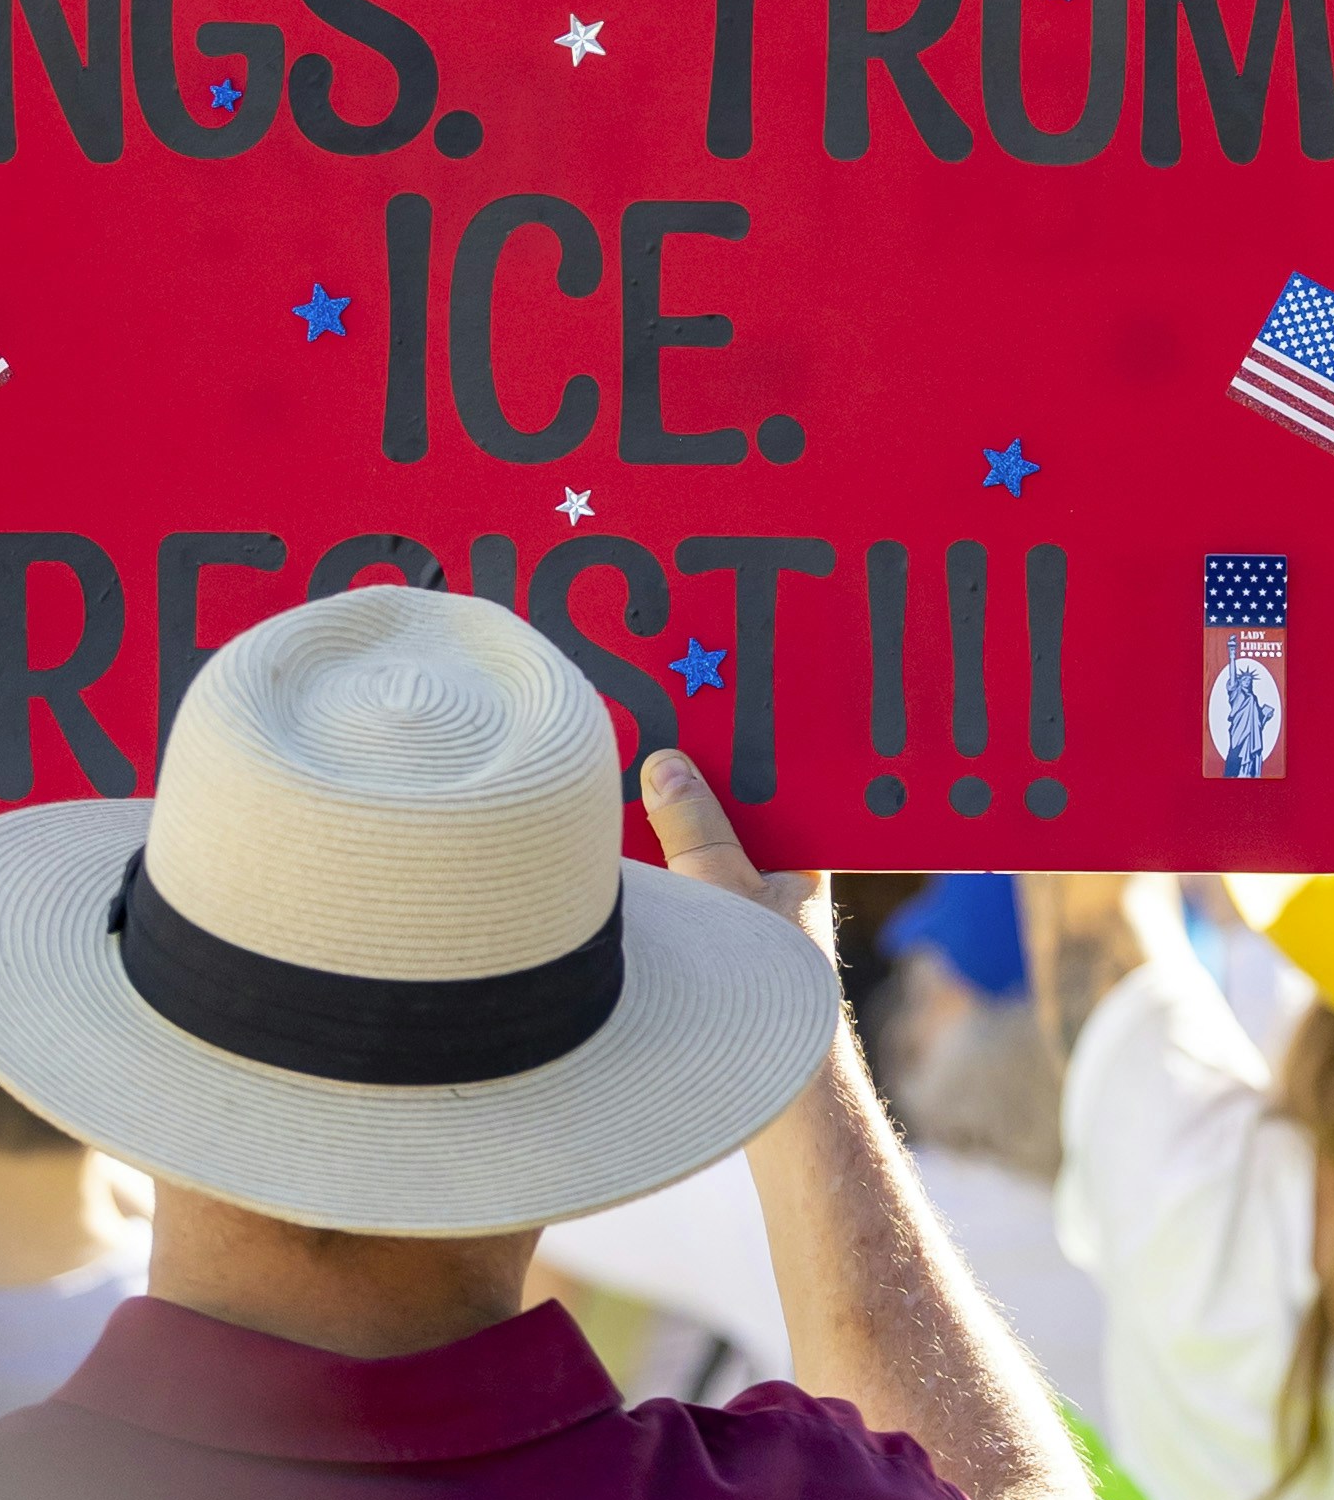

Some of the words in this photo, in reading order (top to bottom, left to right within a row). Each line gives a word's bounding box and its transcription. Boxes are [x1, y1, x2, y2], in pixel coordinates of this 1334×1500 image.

[381, 191, 806, 466] ICE.
[1240, 630, 1266, 640] LADY
[1240, 641, 1283, 651] LIBERTY
